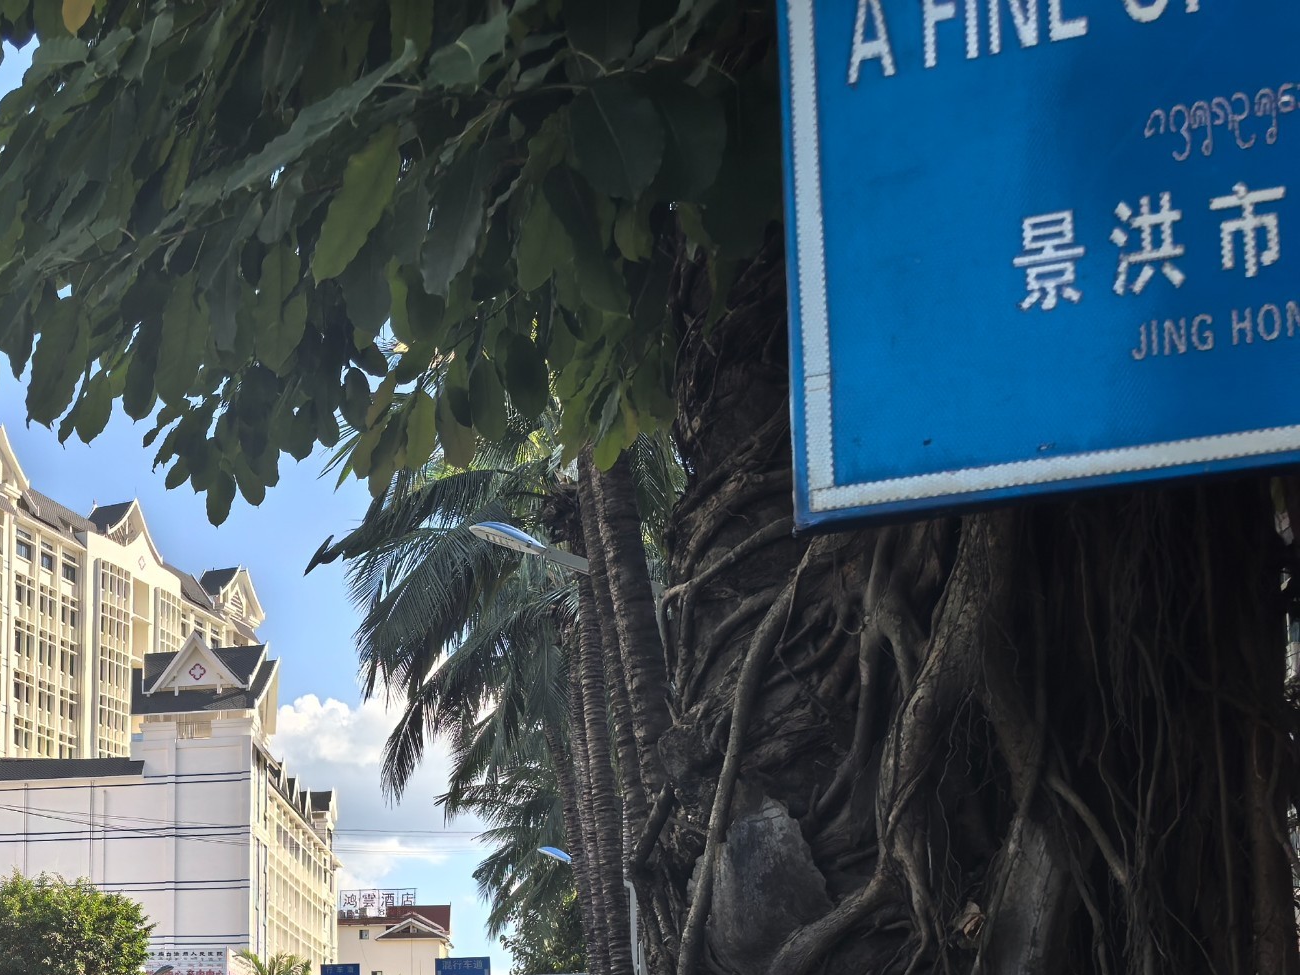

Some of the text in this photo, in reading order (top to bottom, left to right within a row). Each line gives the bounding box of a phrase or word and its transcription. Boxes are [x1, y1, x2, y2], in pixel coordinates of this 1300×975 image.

[847, 0, 896, 85] A
[1012, 182, 1287, 311] 景洪市
[1131, 314, 1215, 360] JING
[441, 959, 484, 970] 混行车道
